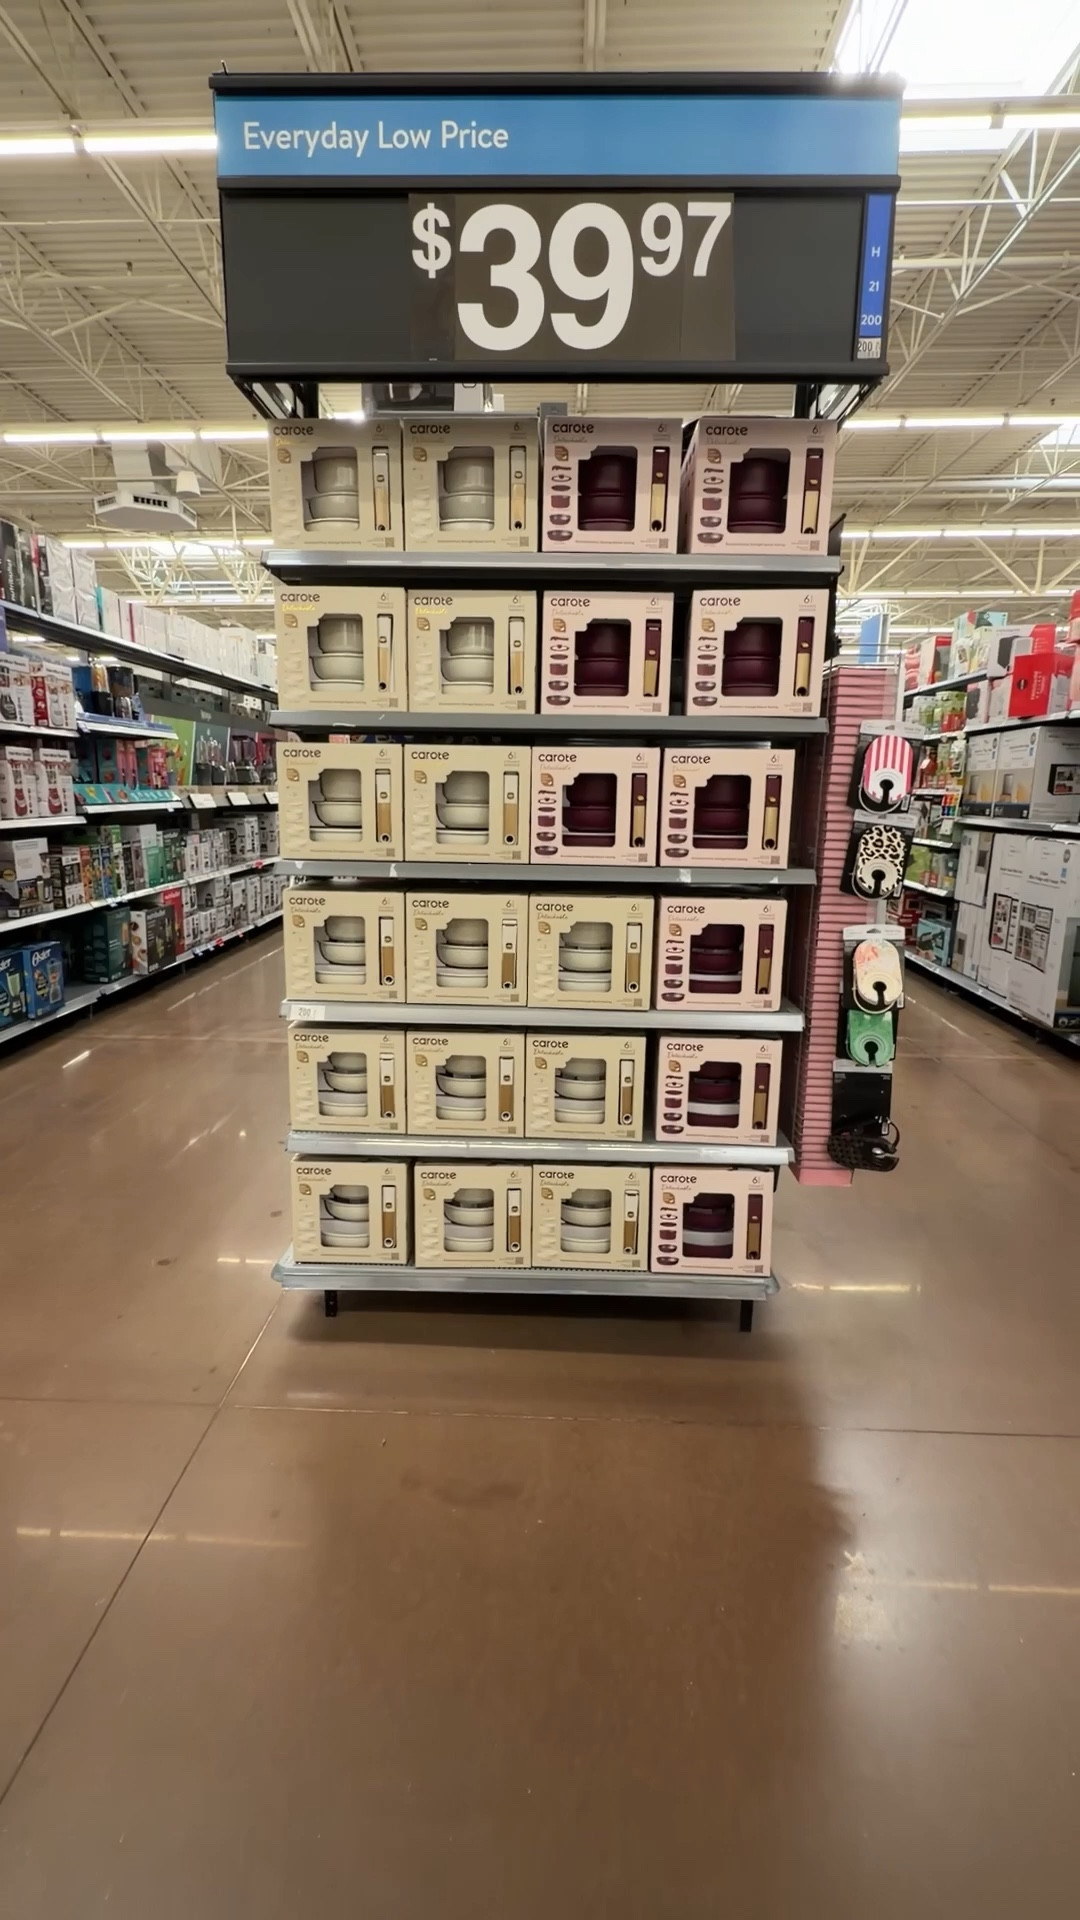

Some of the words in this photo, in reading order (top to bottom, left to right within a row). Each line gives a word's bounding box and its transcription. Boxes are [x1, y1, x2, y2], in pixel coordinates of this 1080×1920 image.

[243, 121, 369, 157] Everyday
[377, 121, 431, 149] Low
[441, 120, 509, 149] Price
[871, 247, 881, 257] H
[868, 281, 880, 292] 21
[861, 315, 882, 326] 200
[273, 426, 314, 436] carote
[409, 424, 451, 434] carote
[552, 423, 594, 433] carote
[705, 426, 748, 436] carote
[280, 593, 321, 602] carote
[414, 596, 453, 606] carote
[699, 597, 741, 606] carote
[550, 598, 591, 607] carote
[283, 749, 322, 758] carote
[411, 751, 450, 760] carote
[538, 754, 577, 763] carote
[671, 755, 711, 764] carote
[289, 897, 326, 906] carote
[412, 899, 450, 909] carote
[535, 903, 574, 912] carote
[667, 905, 705, 914] carote
[293, 1033, 329, 1042] carote
[412, 1037, 449, 1046] carote
[532, 1040, 569, 1049] carote
[666, 1042, 704, 1051] carote
[296, 1167, 332, 1175] carote
[420, 1171, 457, 1179] carote
[539, 1171, 575, 1179] carote
[660, 1175, 697, 1183] carote
